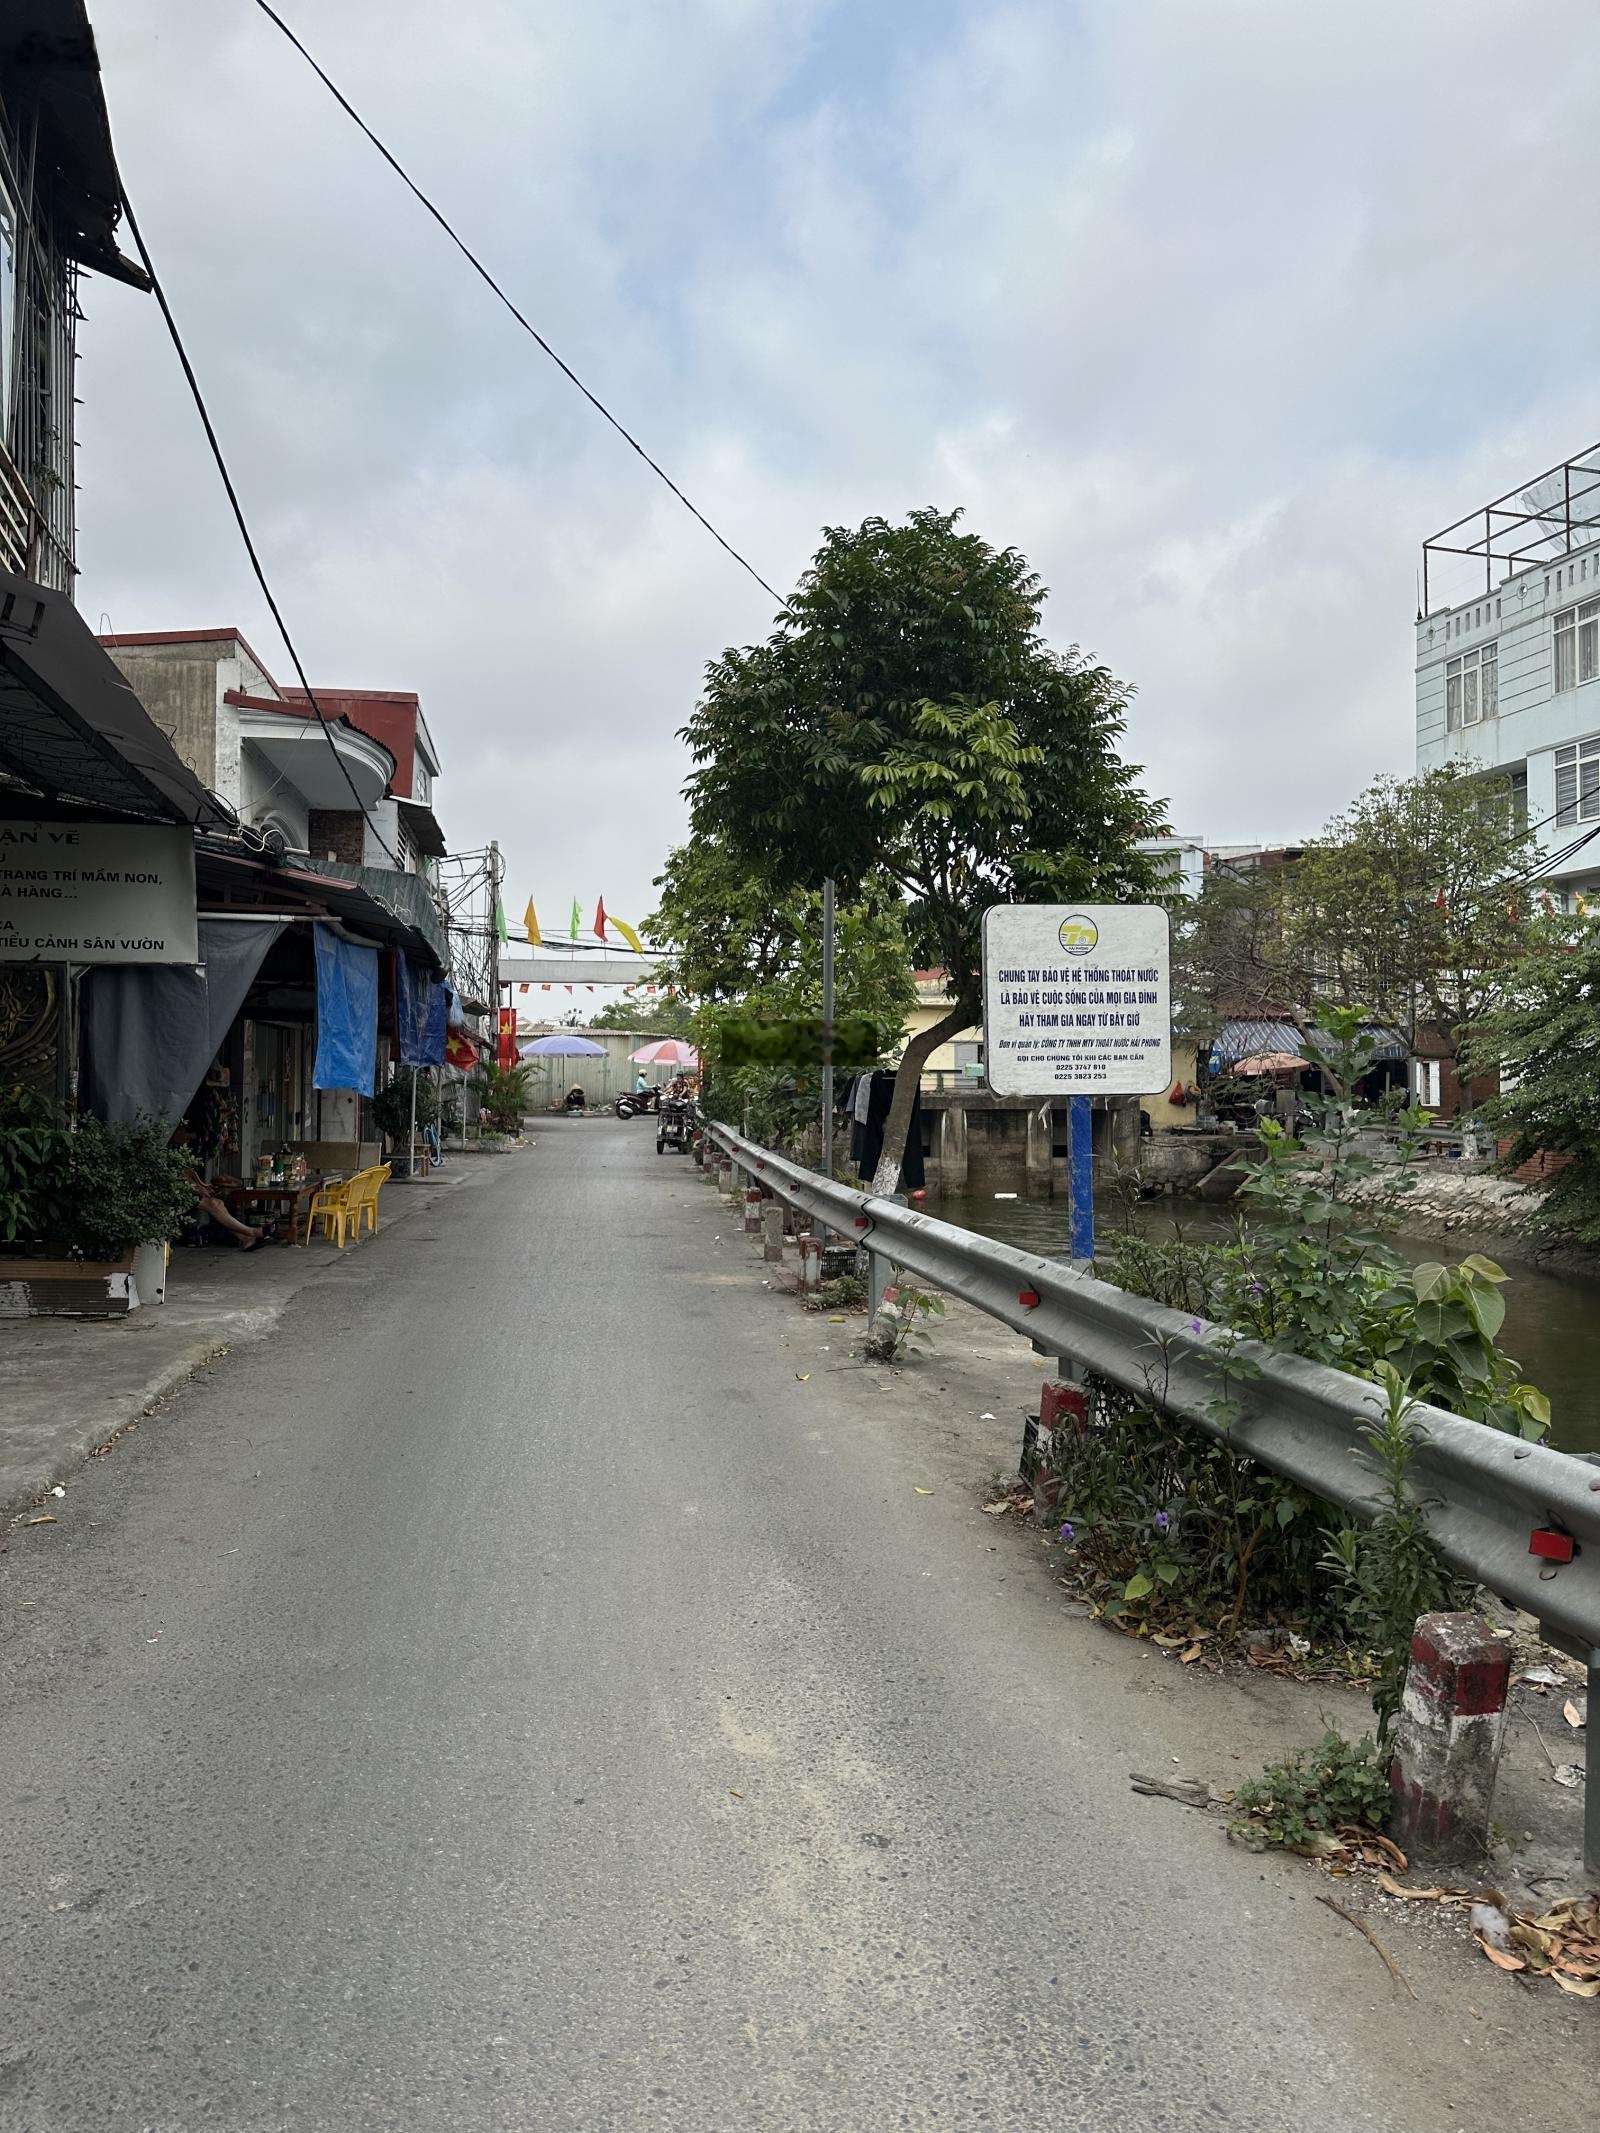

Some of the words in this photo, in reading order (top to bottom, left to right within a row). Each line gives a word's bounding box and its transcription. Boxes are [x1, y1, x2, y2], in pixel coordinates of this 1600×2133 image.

[52, 868, 77, 881] TRÍ
[125, 873, 162, 885] NON,
[34, 934, 78, 949] CẢNH
[83, 937, 115, 949] SÂN
[121, 936, 164, 950] VƯỜN
[998, 969, 1026, 982] CHUNG
[1027, 969, 1040, 982] TAY
[1042, 966, 1058, 982] BẢO
[1060, 967, 1070, 985] VỆ
[1072, 967, 1082, 985] HỆ
[1083, 964, 1110, 982] THỐNG
[1111, 967, 1136, 982] THOÁT
[1137, 967, 1159, 982] NƯỚC
[1001, 989, 1010, 1005] LÀ
[1012, 988, 1028, 1005] BẢO
[1030, 989, 1040, 1007] VỆ
[1042, 989, 1063, 1007] CUỘC
[1065, 988, 1087, 1004] SỐNG
[1088, 988, 1104, 1004] CỦA
[1106, 991, 1121, 1007] MỌI
[1123, 991, 1137, 1004] GIA
[1138, 989, 1157, 1004] ĐÌNH
[1019, 1012, 1034, 1027] HÃY
[1037, 1014, 1059, 1027] THAM
[1061, 1014, 1074, 1027] GIA
[1076, 1014, 1096, 1026] NGAY
[1098, 1011, 1109, 1026] TỪ
[1109, 1011, 1125, 1026] BÂY
[1126, 1011, 1140, 1026] GIỜ
[1041, 1037, 1057, 1048] CÔNG
[1058, 1039, 1066, 1048] TY
[1066, 1038, 1081, 1048] TNHH
[1081, 1038, 1095, 1047] MTV
[1072, 1053, 1083, 1061] TÔI
